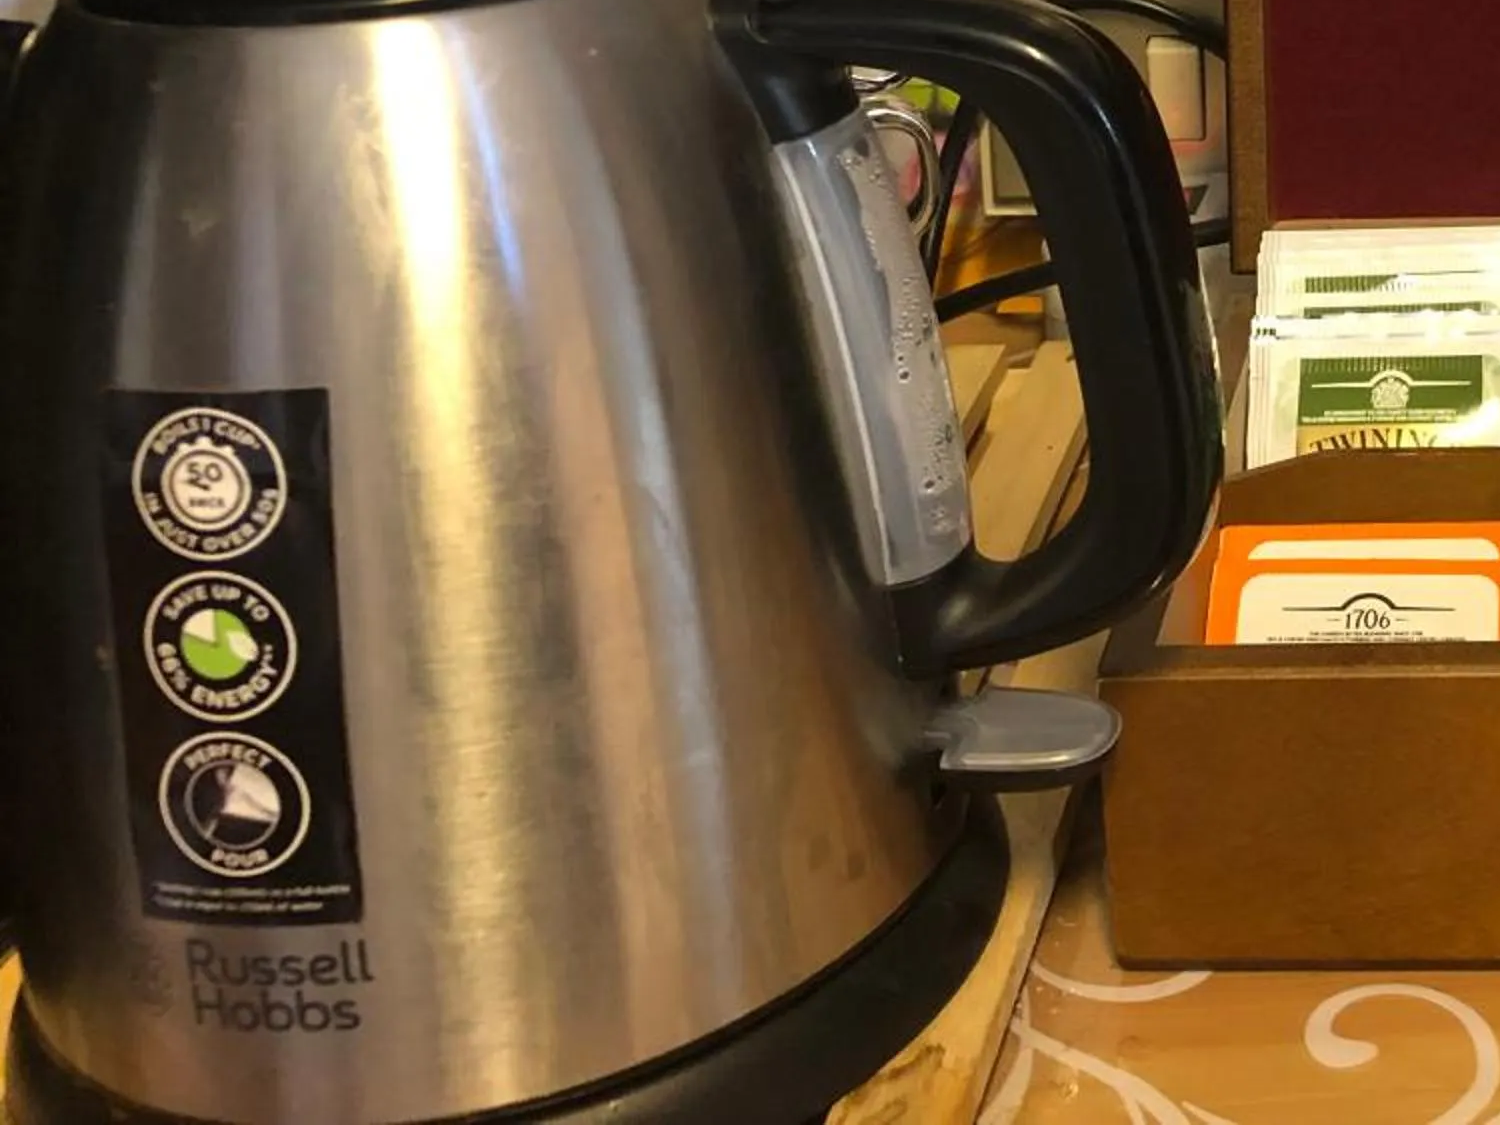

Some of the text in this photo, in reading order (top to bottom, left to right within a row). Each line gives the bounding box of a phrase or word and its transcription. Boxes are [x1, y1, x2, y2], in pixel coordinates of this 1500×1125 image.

[187, 462, 222, 482] 50
[144, 492, 161, 513] IN
[156, 518, 199, 549] JUST
[201, 522, 256, 552] OVER
[162, 584, 271, 622] SAVE UP TO
[1344, 608, 1392, 630] 1706
[184, 742, 273, 771] PERFECT
[211, 847, 270, 868] POUR
[185, 937, 375, 987] Russell
[191, 985, 362, 1033] Hobbs
